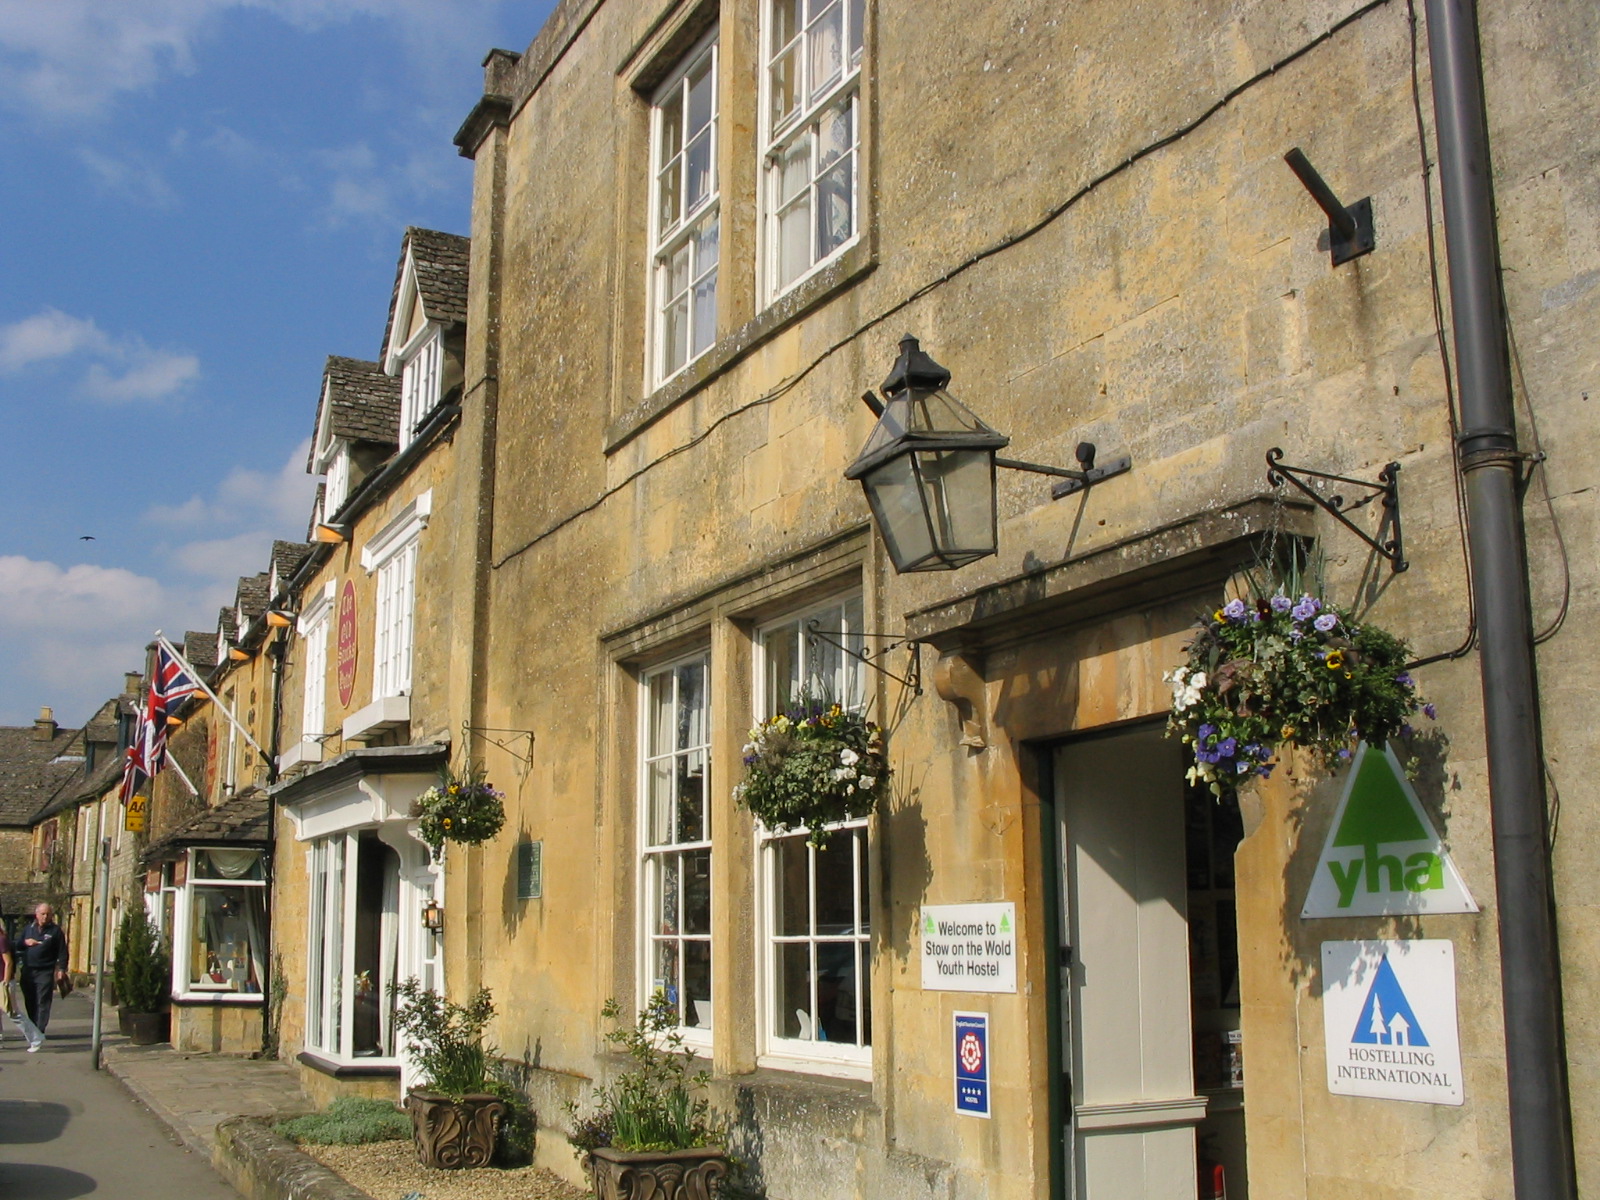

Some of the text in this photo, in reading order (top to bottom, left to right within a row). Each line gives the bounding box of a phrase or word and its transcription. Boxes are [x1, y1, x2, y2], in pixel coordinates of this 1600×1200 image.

[1327, 843, 1444, 908] yha
[938, 921, 983, 936] Welcome
[985, 921, 996, 935] to
[925, 940, 1011, 956] Stow on the Wold
[936, 960, 999, 976] Youth Hostel
[1349, 1047, 1435, 1067] HOSTELLING
[1337, 1065, 1452, 1087] INTERNATIONAL
